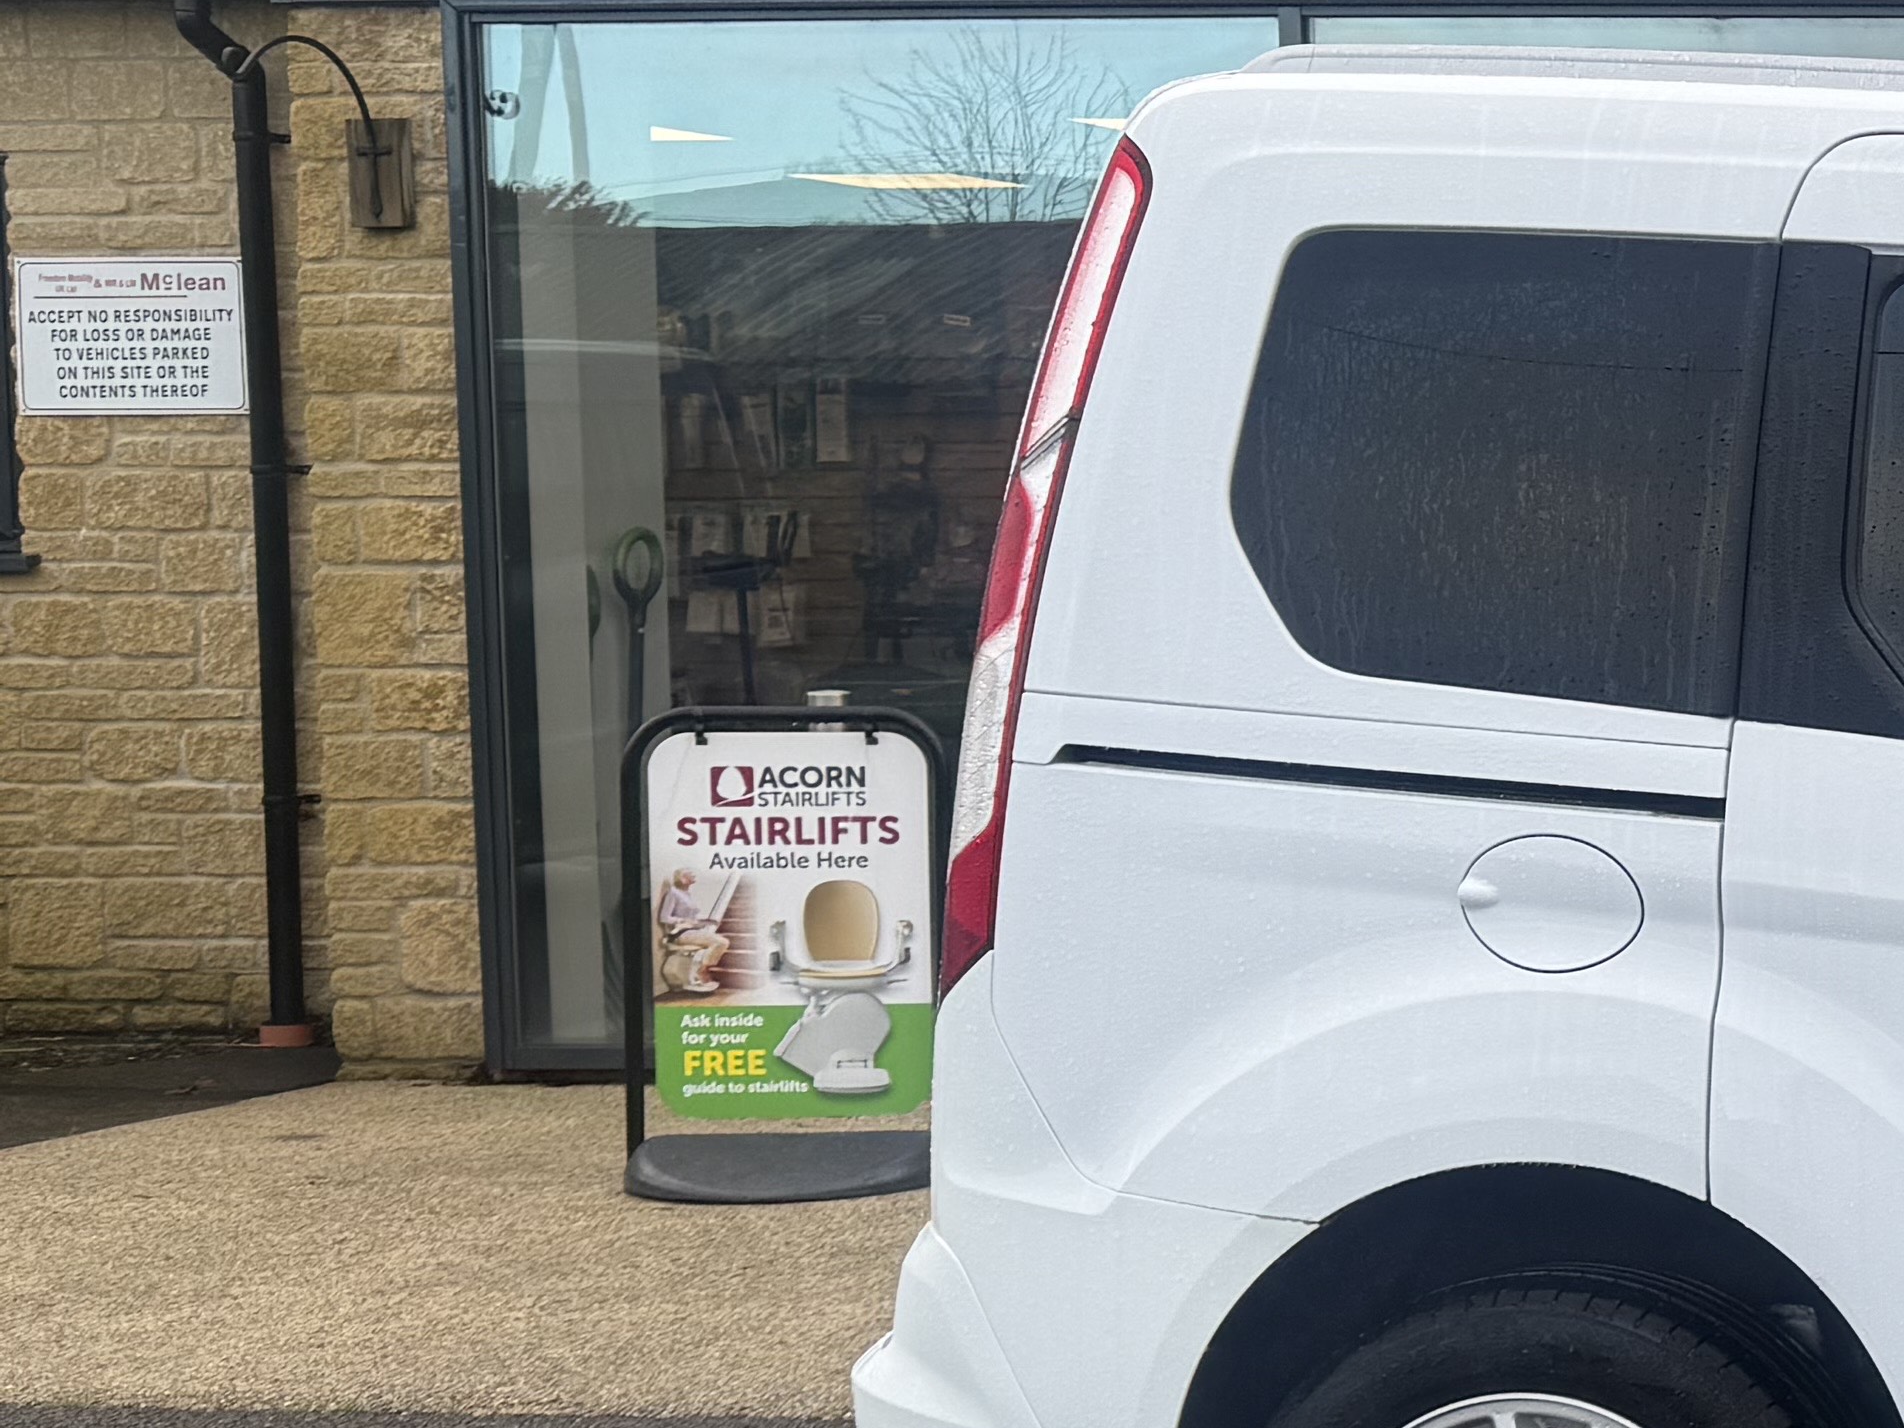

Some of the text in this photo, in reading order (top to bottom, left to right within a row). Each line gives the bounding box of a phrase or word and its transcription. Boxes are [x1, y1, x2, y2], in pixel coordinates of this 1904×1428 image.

[29, 309, 233, 323] ACCEPT NO RESPONSIBILITY
[51, 328, 211, 342] FOR LOSS OR DAMAGE
[54, 347, 209, 361] TO VEHICLES PARKED
[57, 366, 208, 379] ON THIS SITE OR THE
[60, 384, 208, 398] CONTENTS THEREOF
[758, 766, 865, 788] ACORN
[758, 791, 866, 807] STAIRLIFTS
[677, 816, 899, 846] STAIRLIFTS
[709, 852, 868, 869] Available Here
[681, 1013, 763, 1027] Ask inside
[682, 1031, 748, 1047] for your
[685, 1051, 766, 1075] FREE
[683, 1080, 808, 1097] guide to stairlifts
